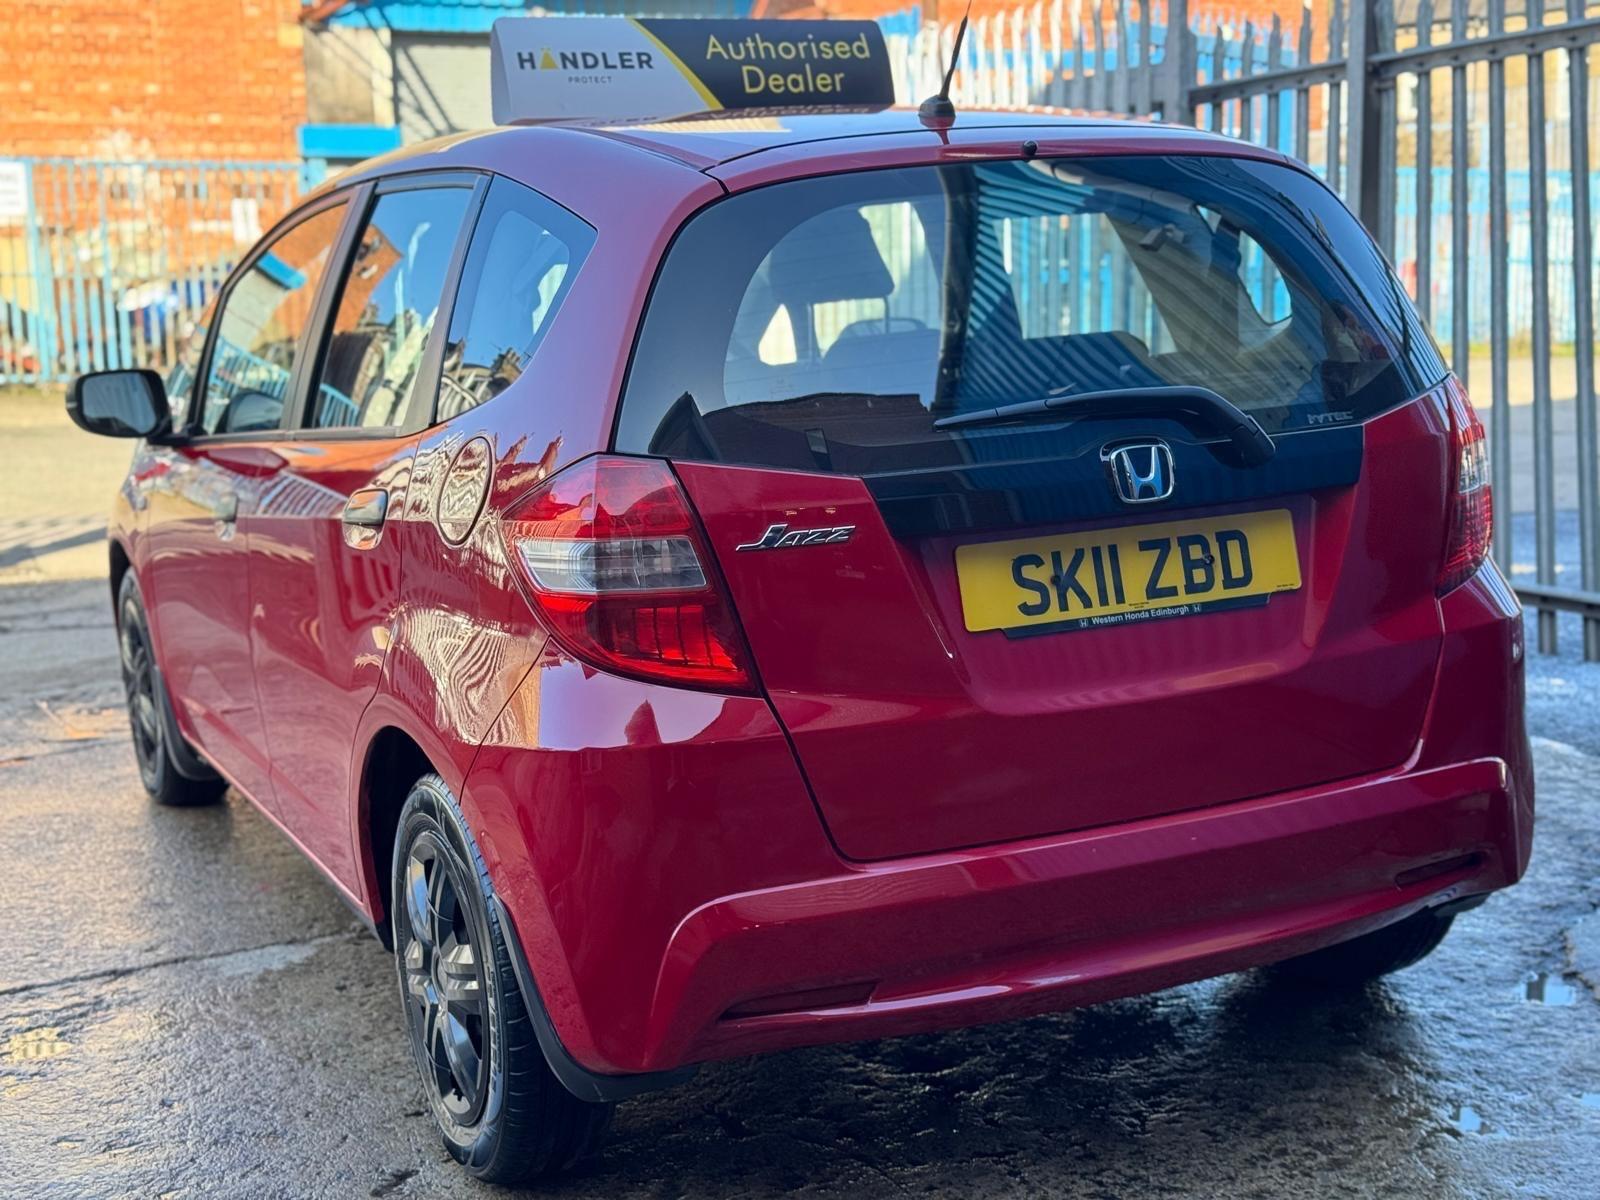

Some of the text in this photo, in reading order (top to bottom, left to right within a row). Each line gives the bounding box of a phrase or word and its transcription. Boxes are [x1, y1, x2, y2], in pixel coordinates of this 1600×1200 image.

[705, 32, 871, 61] Authorised
[568, 75, 612, 84] PROTECT
[742, 64, 845, 94] Dealer
[1139, 529, 1254, 600] ZBD
[1091, 614, 1124, 626] Western
[1125, 609, 1149, 620] Honda
[1151, 605, 1189, 616] Edinburgh
